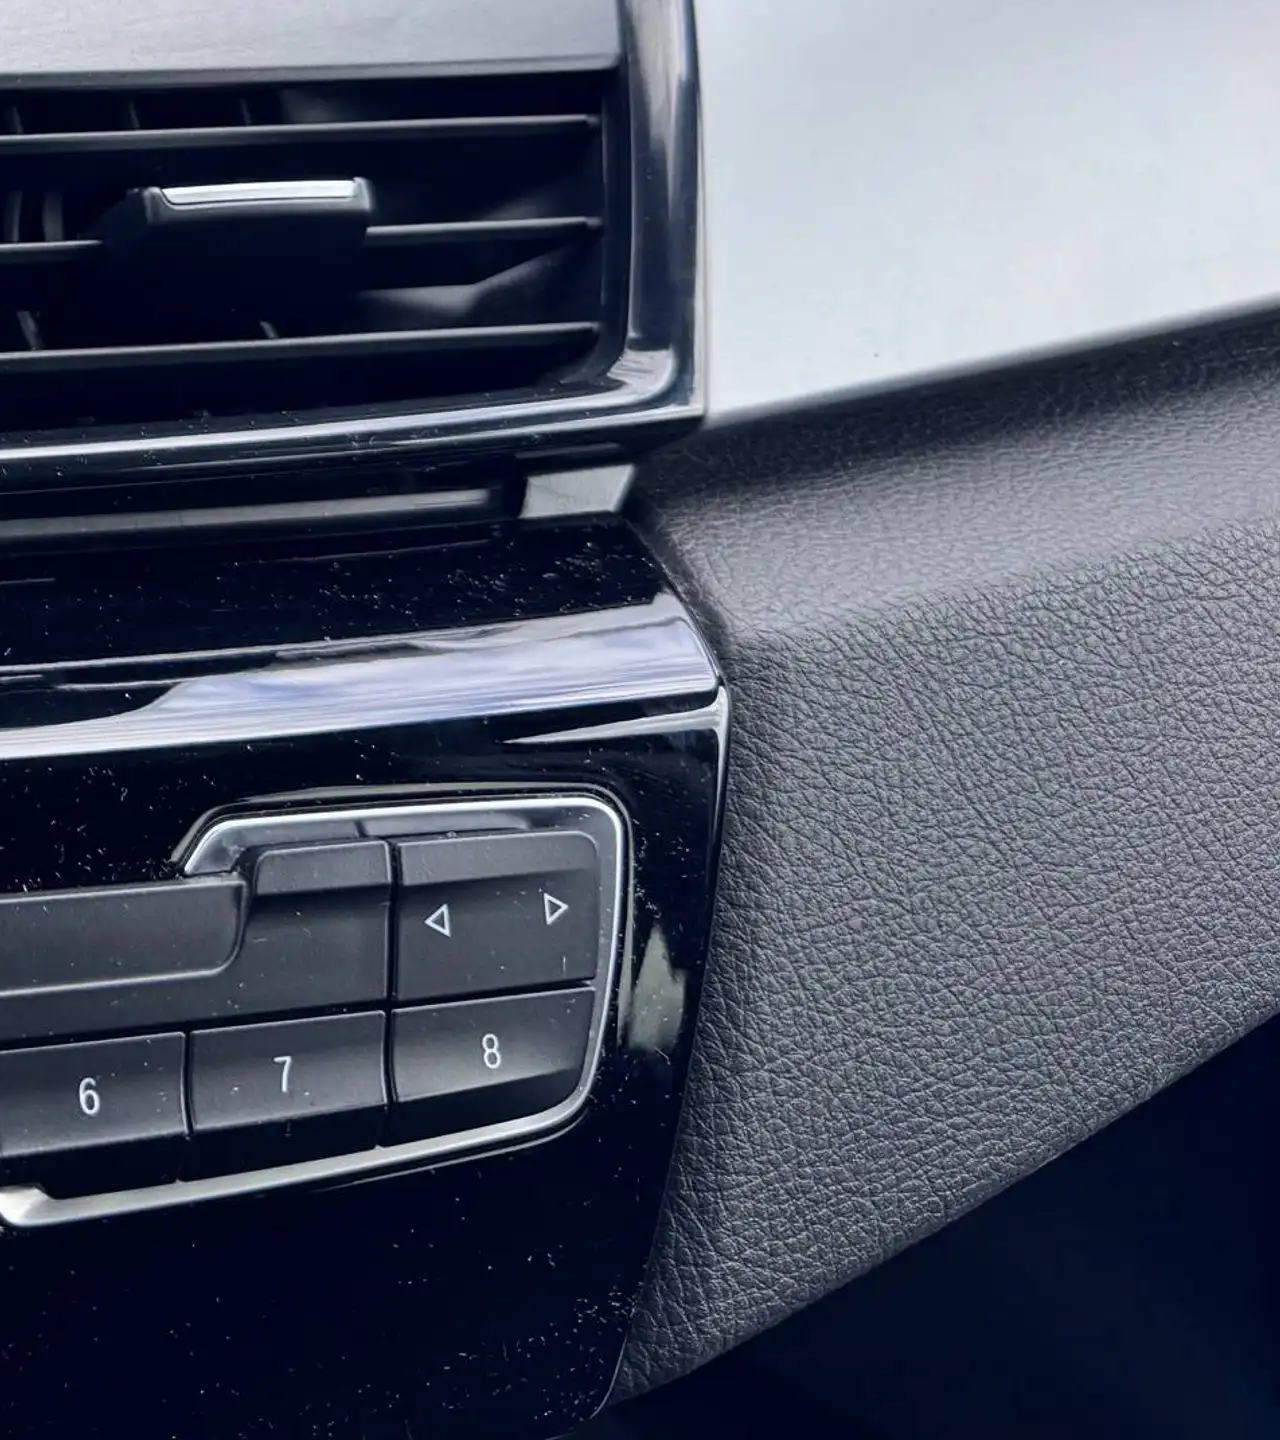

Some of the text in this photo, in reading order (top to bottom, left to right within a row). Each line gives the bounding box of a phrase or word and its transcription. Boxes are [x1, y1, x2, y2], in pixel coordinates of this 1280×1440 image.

[482, 1034, 502, 1070] 8
[274, 1055, 293, 1093] 7
[79, 1077, 101, 1115] 6
